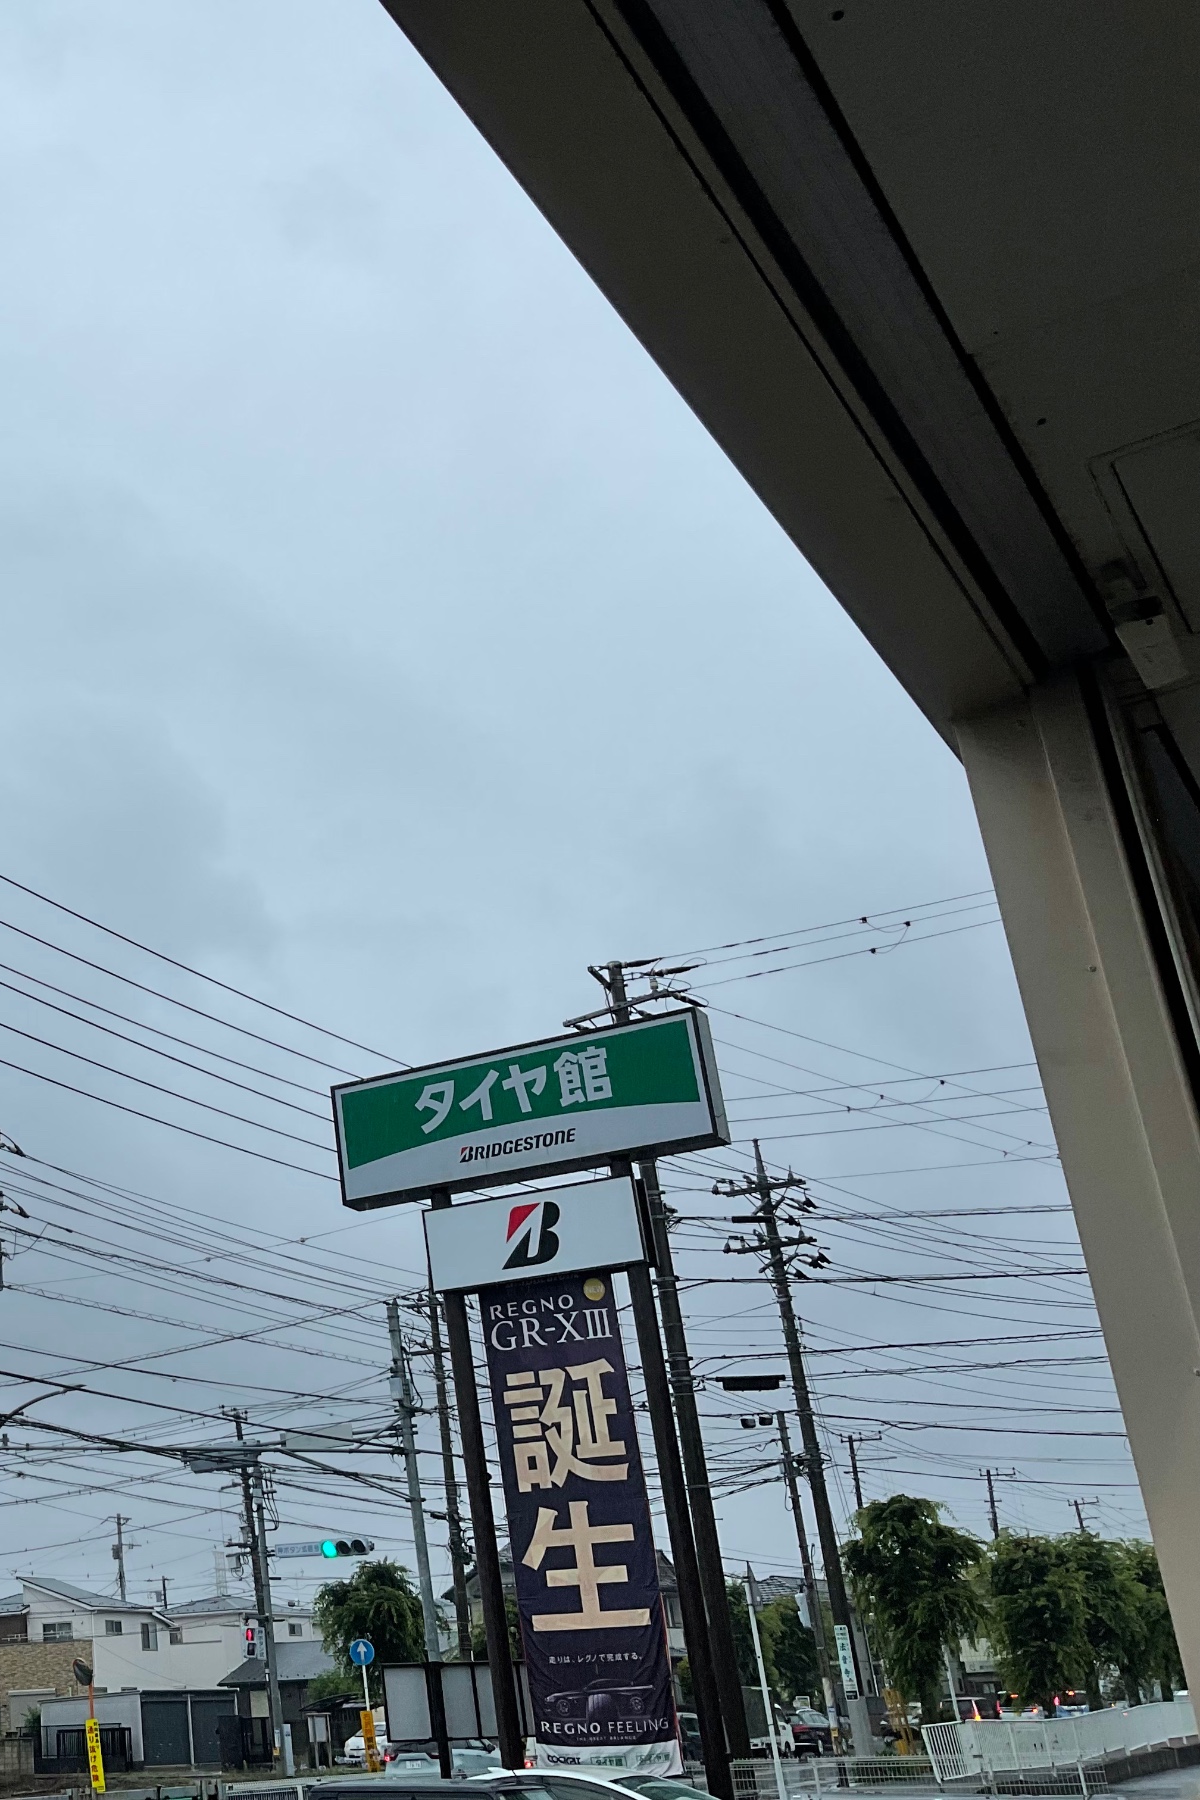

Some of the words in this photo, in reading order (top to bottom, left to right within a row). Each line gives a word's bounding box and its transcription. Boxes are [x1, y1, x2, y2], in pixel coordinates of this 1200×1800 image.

[415, 1046, 612, 1134] タイヤ館
[459, 1128, 576, 1163] BRIDGESTONE
[490, 1294, 574, 1320] REGNO
[503, 1357, 651, 1632] 誕生
[540, 1720, 601, 1735] REGNO
[607, 1717, 669, 1734] FEELING
